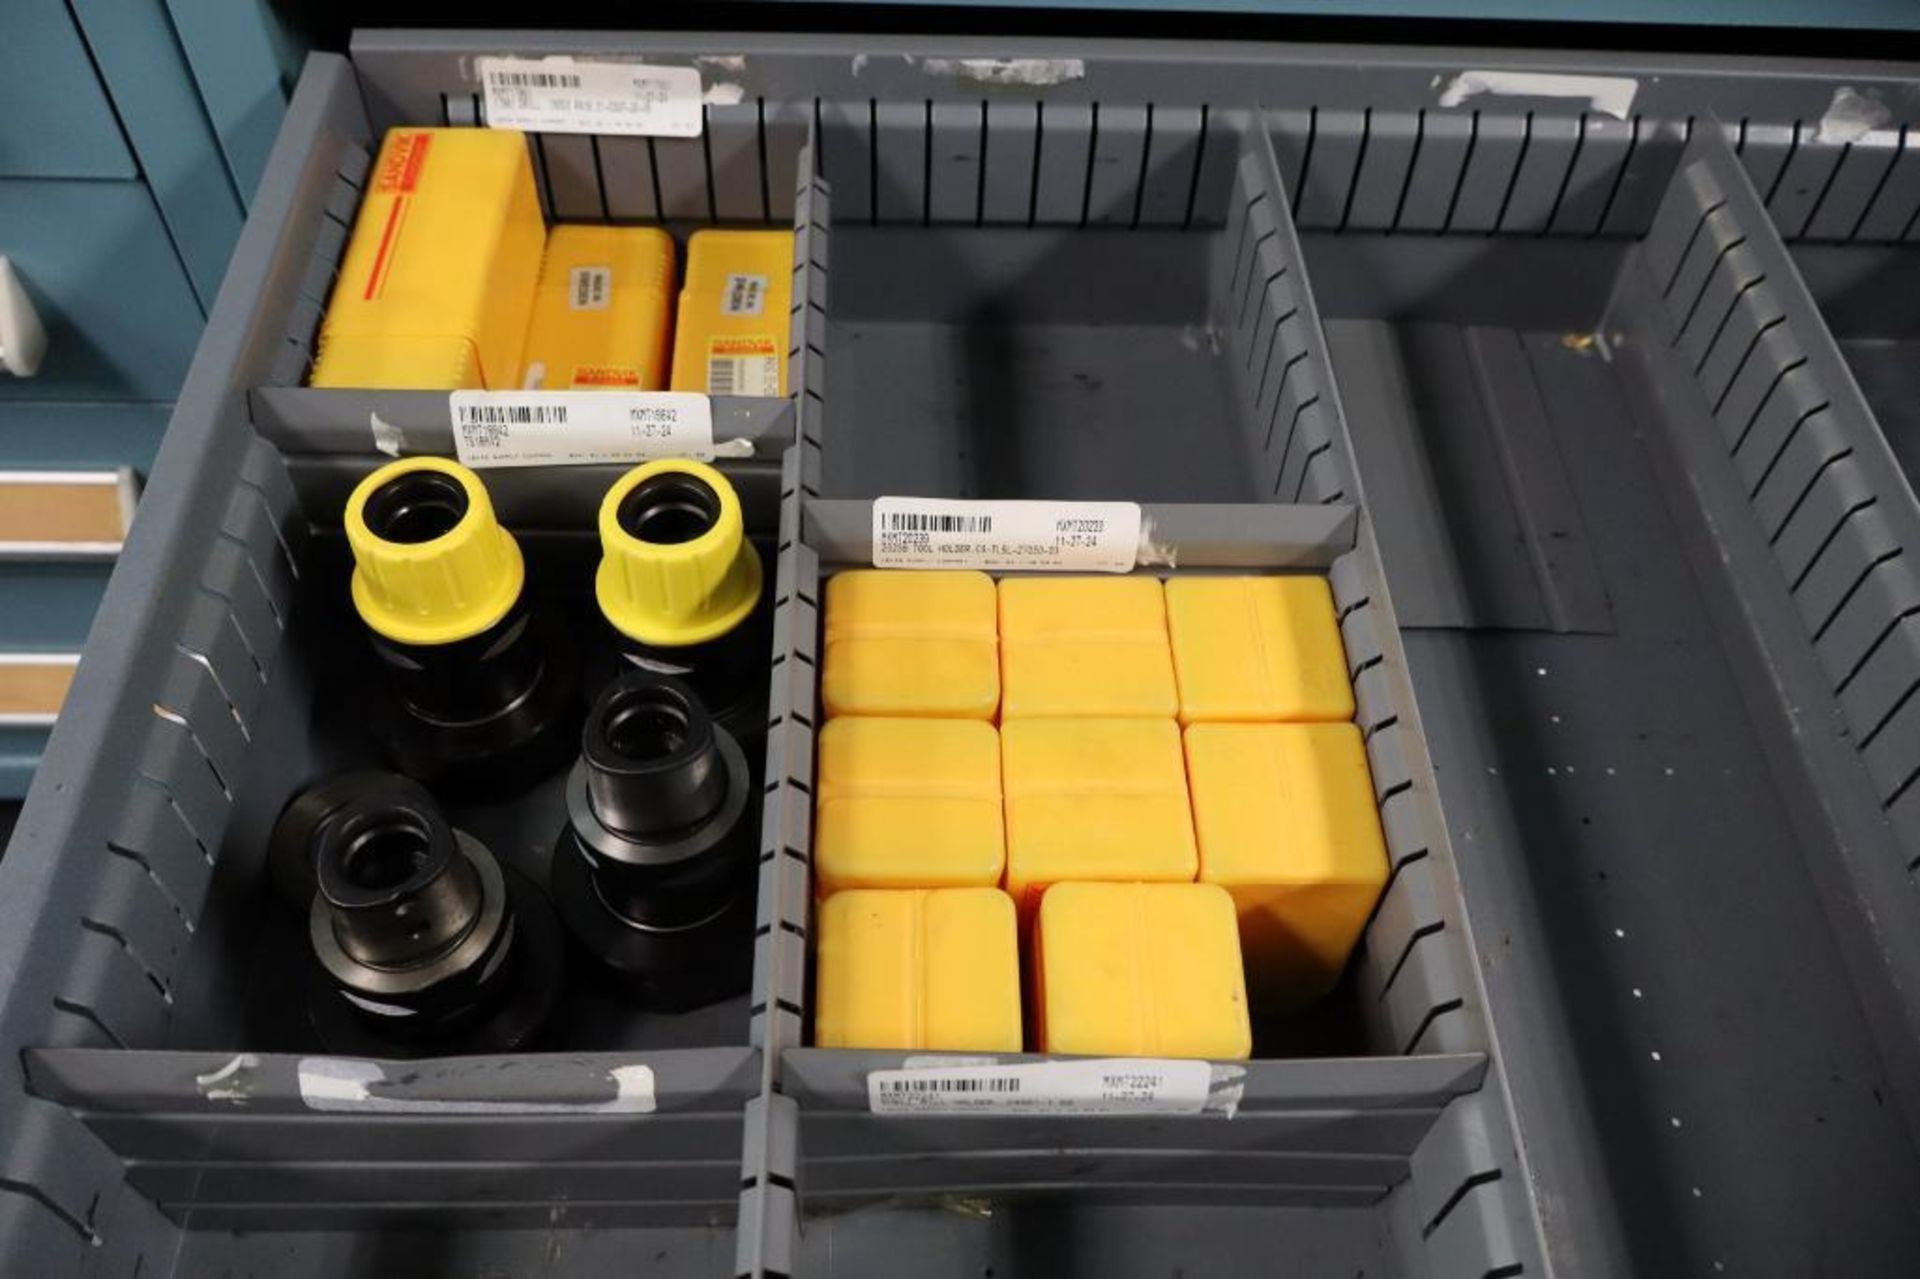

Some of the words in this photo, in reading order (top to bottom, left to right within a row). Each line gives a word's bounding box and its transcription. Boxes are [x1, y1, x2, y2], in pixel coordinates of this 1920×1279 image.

[376, 134, 412, 192] SANDVIK
[631, 424, 672, 437] 11-27-24
[1055, 535, 1097, 547] 11-27-24
[913, 543, 933, 553] TOOL
[938, 544, 971, 553] HOLDER
[1103, 1074, 1163, 1089] MXMT22241
